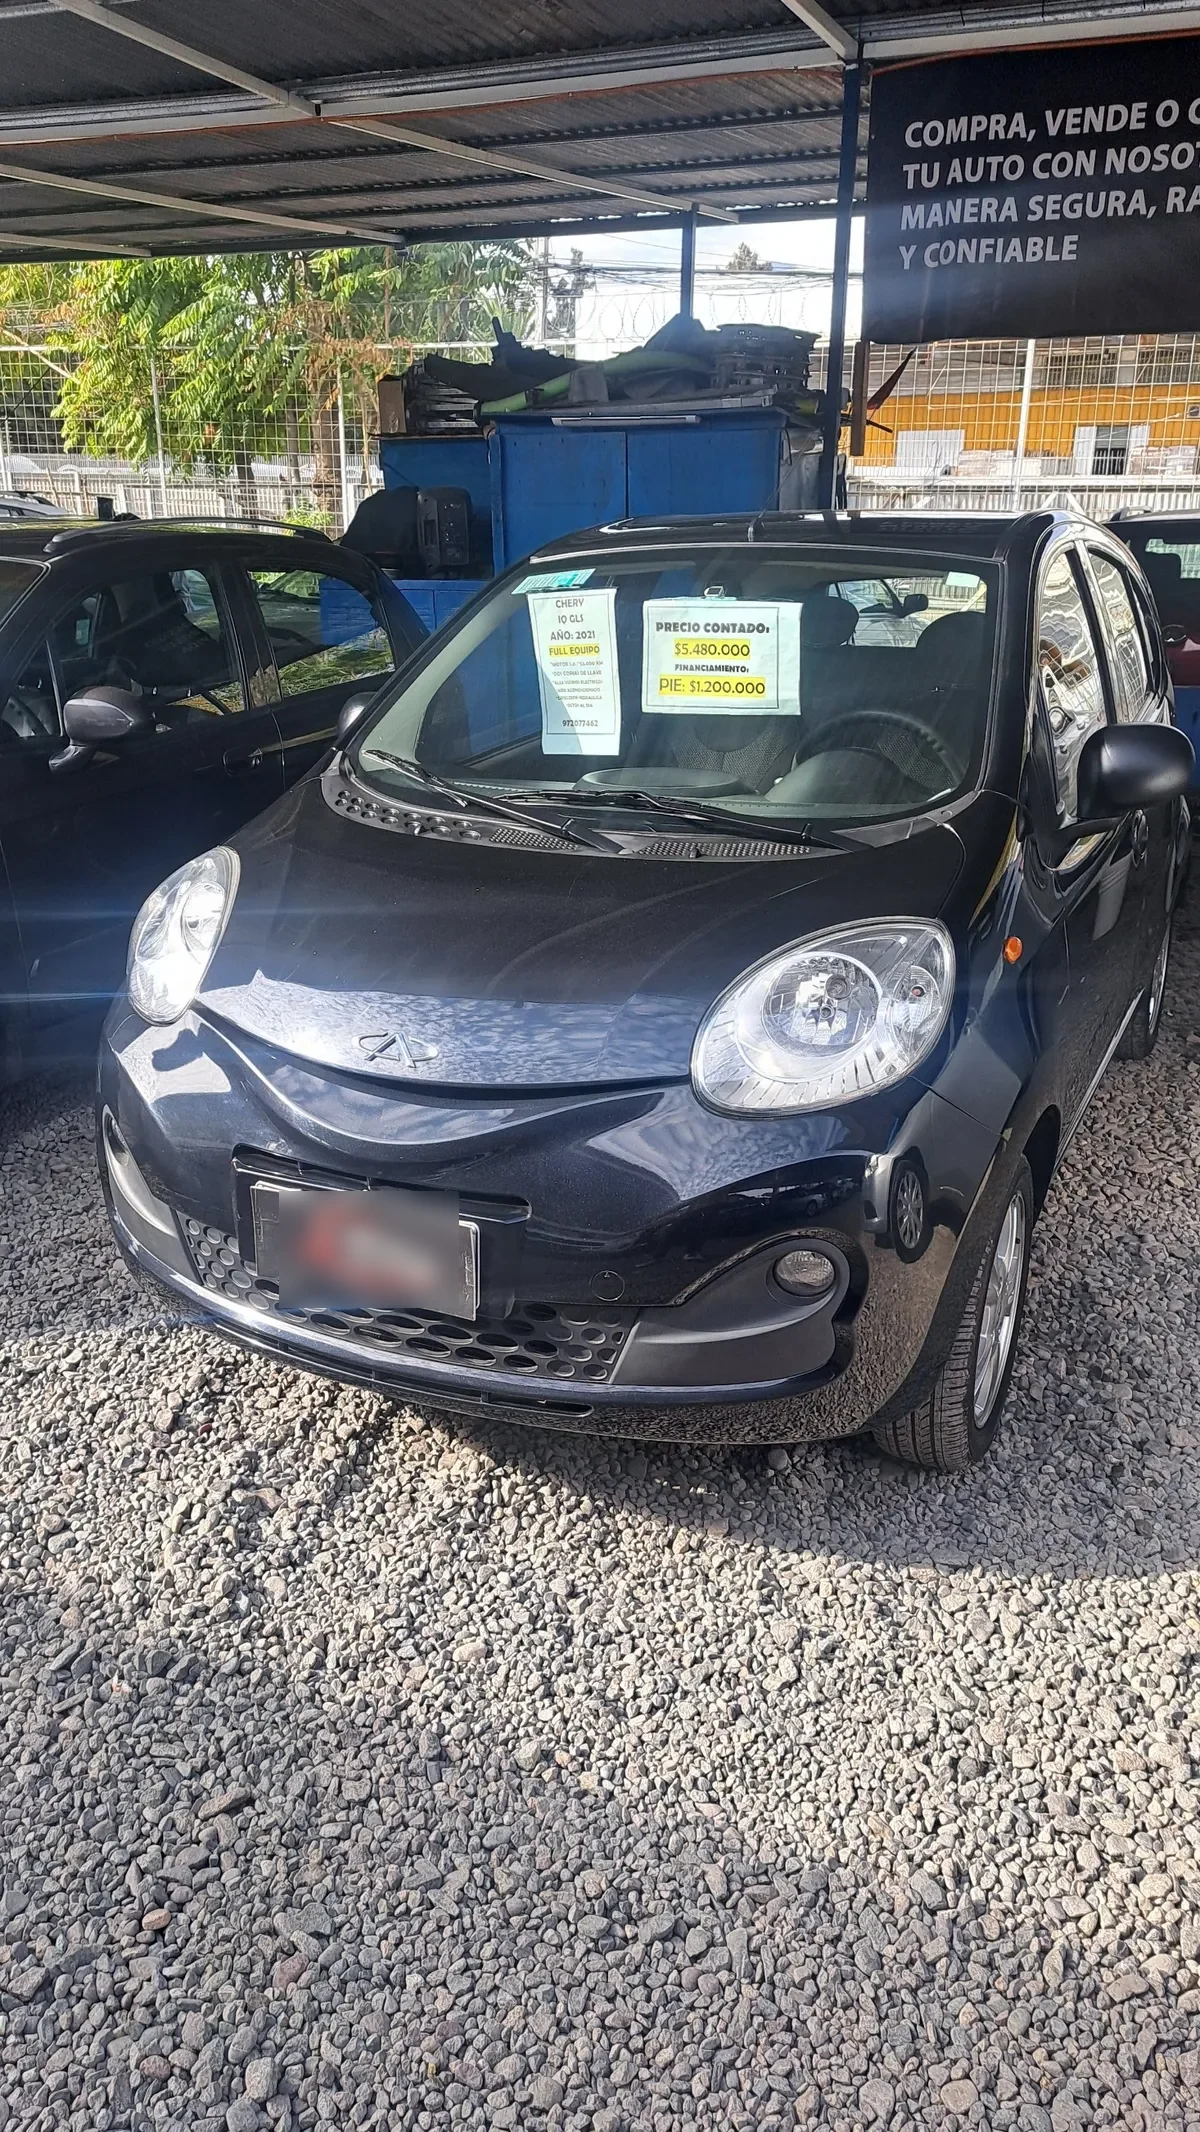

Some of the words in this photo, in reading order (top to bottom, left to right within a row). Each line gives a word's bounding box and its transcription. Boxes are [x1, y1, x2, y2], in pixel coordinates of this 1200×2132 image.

[904, 112, 1037, 148] COMPRA,
[1045, 102, 1148, 136] VENDE
[1155, 99, 1180, 128] O
[903, 162, 940, 189] TU
[947, 155, 1025, 185] AUTO
[1032, 150, 1096, 179] CON
[901, 197, 1018, 230] MANERA
[1027, 189, 1157, 221] SEGURA,
[899, 245, 917, 270] Y
[923, 235, 1079, 268] CONFIABLE
[555, 598, 585, 609] CHERY
[569, 614, 584, 623] GLS
[656, 622, 701, 632] PRECIO
[703, 622, 770, 634] CONTADO:
[550, 629, 574, 641] AÑO:
[575, 630, 596, 640] 2021
[549, 647, 569, 656] FULL
[570, 645, 600, 655] EQUIPO
[674, 642, 751, 657] $5.480.000
[674, 663, 749, 674] FINANCIAMIENTO:
[659, 678, 685, 692] PIE:
[689, 680, 766, 695] $1.200.000
